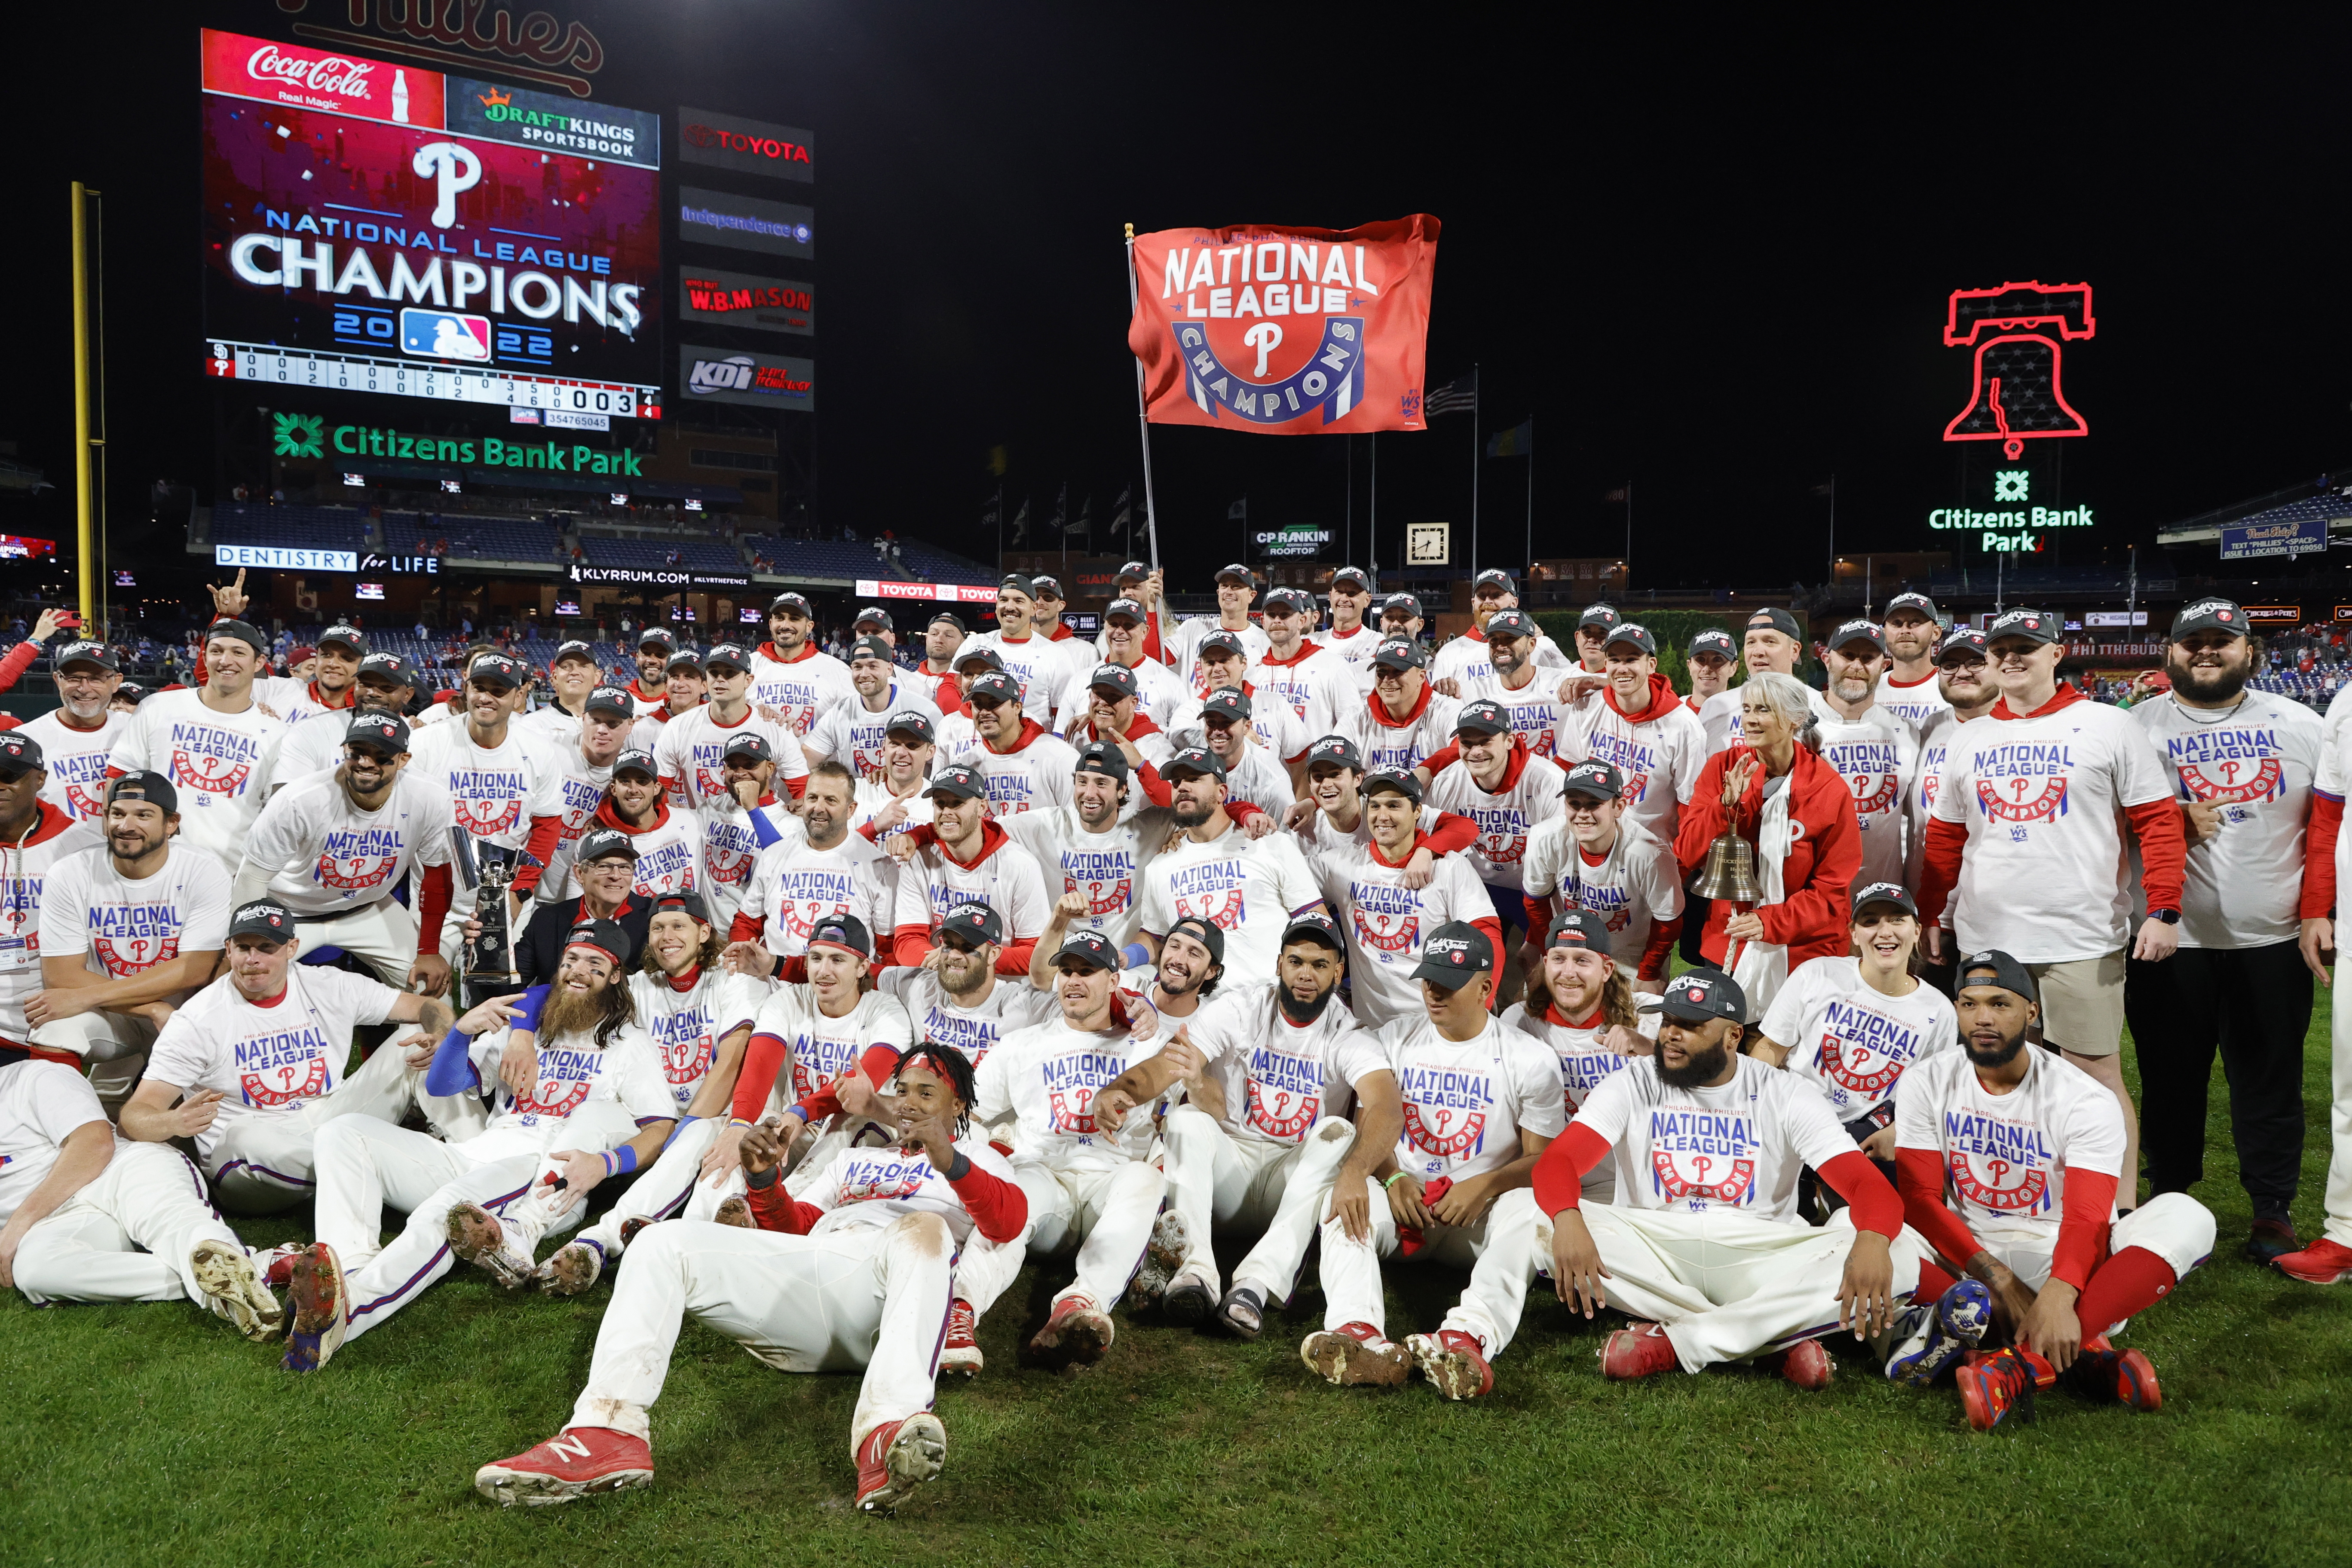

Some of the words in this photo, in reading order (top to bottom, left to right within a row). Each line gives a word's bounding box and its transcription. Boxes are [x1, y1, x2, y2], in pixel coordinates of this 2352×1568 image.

[246, 46, 375, 98] Coca-Cola
[278, 91, 308, 106] Real
[310, 97, 338, 110] Magic
[484, 104, 634, 142] DRAFTKINGS
[523, 127, 633, 157] SPORTSBOOK
[717, 130, 809, 163] TOYOTA
[413, 142, 481, 229] P
[682, 206, 790, 236] Independence
[266, 209, 456, 254] NATIONAL
[474, 239, 610, 274] LEAGUE
[1162, 242, 1378, 299] NATIONAL
[231, 233, 644, 341] CHAMPIONS
[1187, 284, 1348, 318] LEAGUE
[334, 313, 393, 338] 20
[497, 333, 552, 356] 22
[1244, 322, 1283, 377] P
[248, 355, 255, 364] 0
[279, 358, 285, 367] 0
[309, 361, 316, 371] 0
[340, 364, 346, 374] 1
[369, 368, 376, 377] 0
[398, 371, 404, 380] 0
[427, 374, 433, 383] 2
[455, 377, 461, 386] 0
[483, 380, 489, 388] 0
[508, 382, 513, 391] 3
[531, 384, 537, 393] 5
[554, 387, 560, 395] 0
[1182, 322, 1355, 417] CHAMPIONS
[214, 360, 228, 376] P
[248, 368, 255, 377] 0
[279, 371, 286, 380] 0
[309, 374, 316, 384] 2
[340, 377, 346, 387] 0
[369, 380, 376, 389] 0
[398, 383, 404, 392] 0
[427, 386, 433, 395] 0
[455, 389, 461, 398] 2
[508, 395, 514, 403] 4
[531, 396, 537, 405] 6
[554, 399, 560, 407] 0
[574, 391, 586, 408] 0
[597, 393, 609, 410] 0
[619, 395, 631, 413] 3
[644, 395, 652, 405] 4
[645, 407, 652, 417] 4
[549, 414, 606, 427] 354765045
[334, 426, 475, 464] Citizens
[484, 439, 565, 470] Bank
[574, 446, 642, 477] Park
[1929, 506, 2025, 530] Citizens
[2032, 505, 2093, 528] Bank
[1257, 532, 1276, 543] CP
[1278, 531, 1329, 542] RANKIN
[1983, 532, 2036, 552] Park
[2246, 529, 2268, 539] Need
[2270, 524, 2300, 538] Help?
[220, 548, 350, 568] DENTISTRY
[361, 554, 386, 570] for
[392, 557, 438, 573] LIFE
[2252, 545, 2287, 555] LOCATION
[583, 568, 689, 584] KLYRRUM.COM
[694, 577, 747, 585] #KLYRTHEFENCE
[882, 584, 934, 597] TOYOTA
[2180, 603, 2207, 623] World
[2203, 603, 2233, 615] Series
[757, 683, 818, 701] NATIONAL
[765, 695, 809, 704] LEAGUE
[172, 724, 258, 760] NATIONAL
[2180, 726, 2232, 736] PHILADELPHIA
[183, 742, 245, 763] LEAGUE
[1988, 740, 2032, 749] PHILADELPHIA
[2168, 730, 2283, 759] NATIONAL
[2187, 747, 2270, 763] LEAGUE
[175, 751, 248, 792] CHAMPIONS
[1974, 745, 2074, 773] NATIONAL
[1984, 764, 2059, 777] LEAGUE
[450, 772, 527, 791] NATIONAL
[459, 789, 516, 799] LEAGUE
[1980, 778, 2063, 819] CHAMPIONS
[456, 801, 519, 834] CHAMPIONS
[1061, 851, 1135, 870] NATIONAL
[781, 873, 855, 896] NATIONAL
[1070, 869, 1125, 880] LEAGUE
[1170, 860, 1246, 892] NATIONAL
[789, 889, 845, 902] LEAGUE
[1180, 879, 1235, 897] LEAGUE
[1350, 882, 1424, 908] NATIONAL
[1358, 902, 1413, 915] LEAGUE
[1356, 911, 1418, 948] CHAMPIONS
[1825, 1002, 1920, 1057] NATIONAL
[235, 1027, 327, 1067] NATIONAL
[1834, 1026, 1905, 1061] LEAGUE
[249, 1049, 318, 1072] LEAGUE
[1251, 1047, 1324, 1086] NATIONAL
[1825, 1037, 1901, 1090] CHAMPIONS
[1256, 1072, 1314, 1095] LEAGUE
[1401, 1067, 1494, 1105] NATIONAL
[1248, 1083, 1316, 1134] CHAMPIONS
[1411, 1091, 1480, 1110] LEAGUE
[1405, 1104, 1484, 1154] CHAMPIONS
[1652, 1112, 1760, 1147] NATIONAL
[1947, 1112, 2052, 1159] NATIONAL
[1665, 1136, 1747, 1157] LEAGUE
[1960, 1140, 2036, 1167] LEAGUE
[1951, 1154, 2043, 1208] CHAMPIONS
